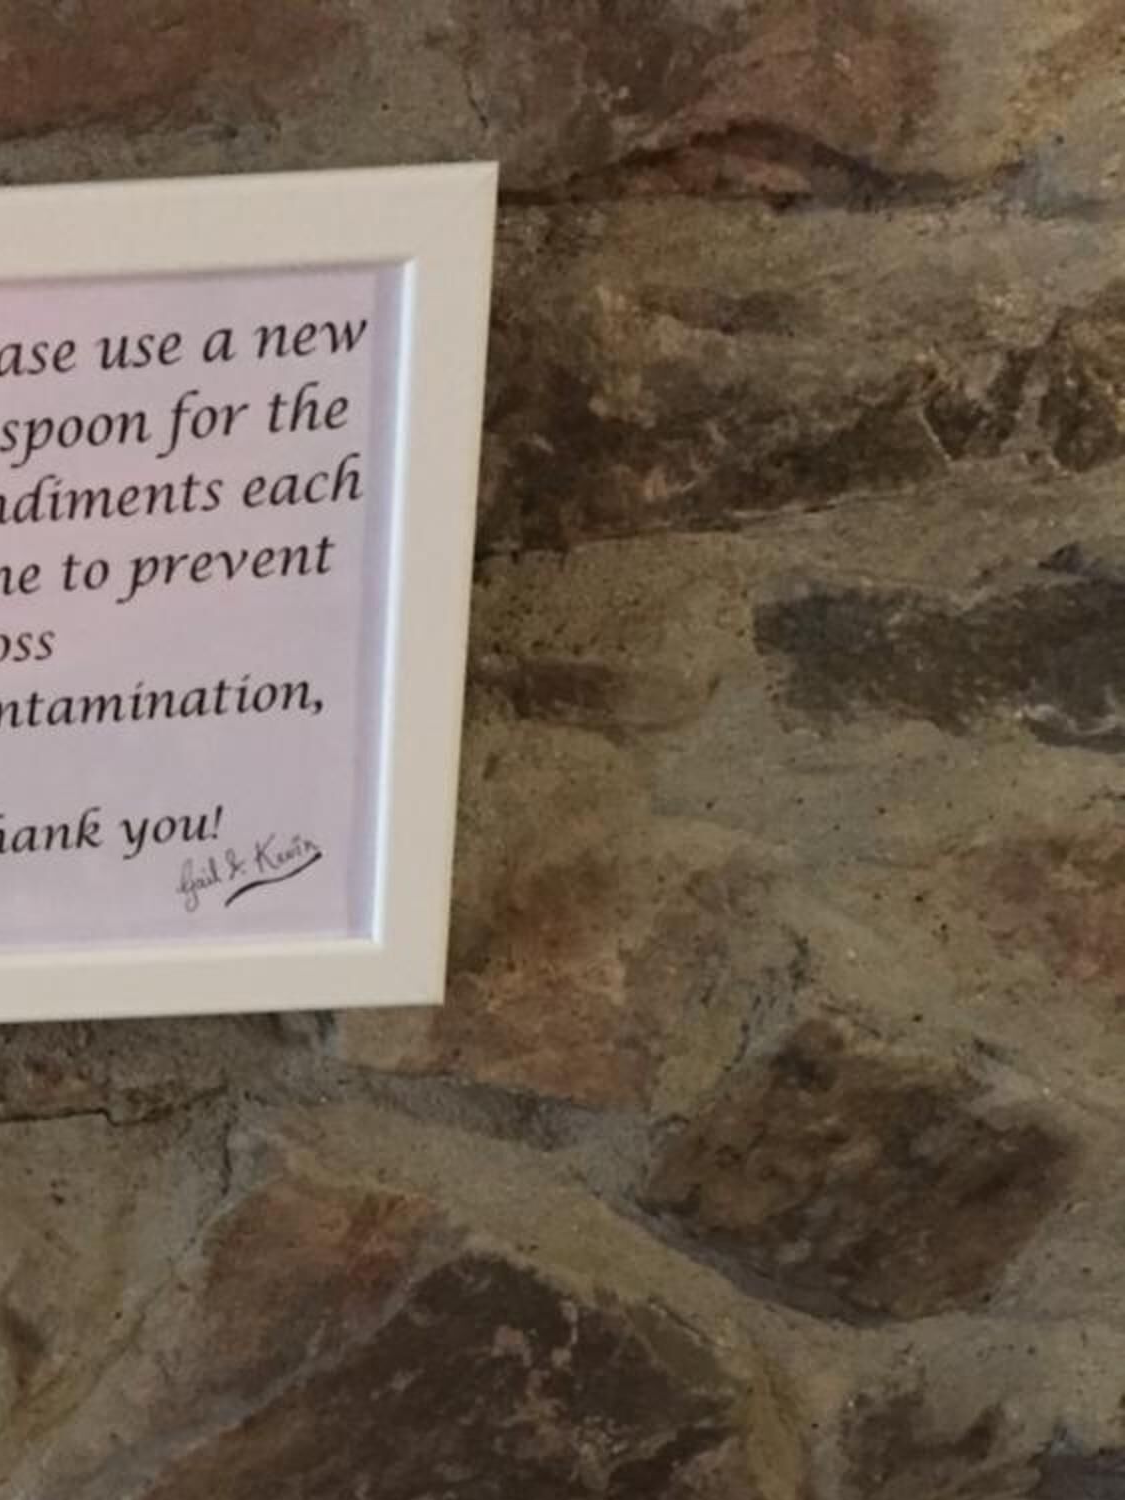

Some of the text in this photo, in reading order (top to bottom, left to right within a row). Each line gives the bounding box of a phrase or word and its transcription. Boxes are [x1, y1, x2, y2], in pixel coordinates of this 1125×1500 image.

[97, 332, 182, 370] use
[203, 328, 236, 363] a
[254, 318, 368, 359] new
[156, 388, 250, 460] for
[268, 381, 350, 434] the
[242, 452, 363, 508] each
[62, 554, 111, 591] to
[116, 536, 335, 604] prevent
[120, 804, 223, 862] you!
